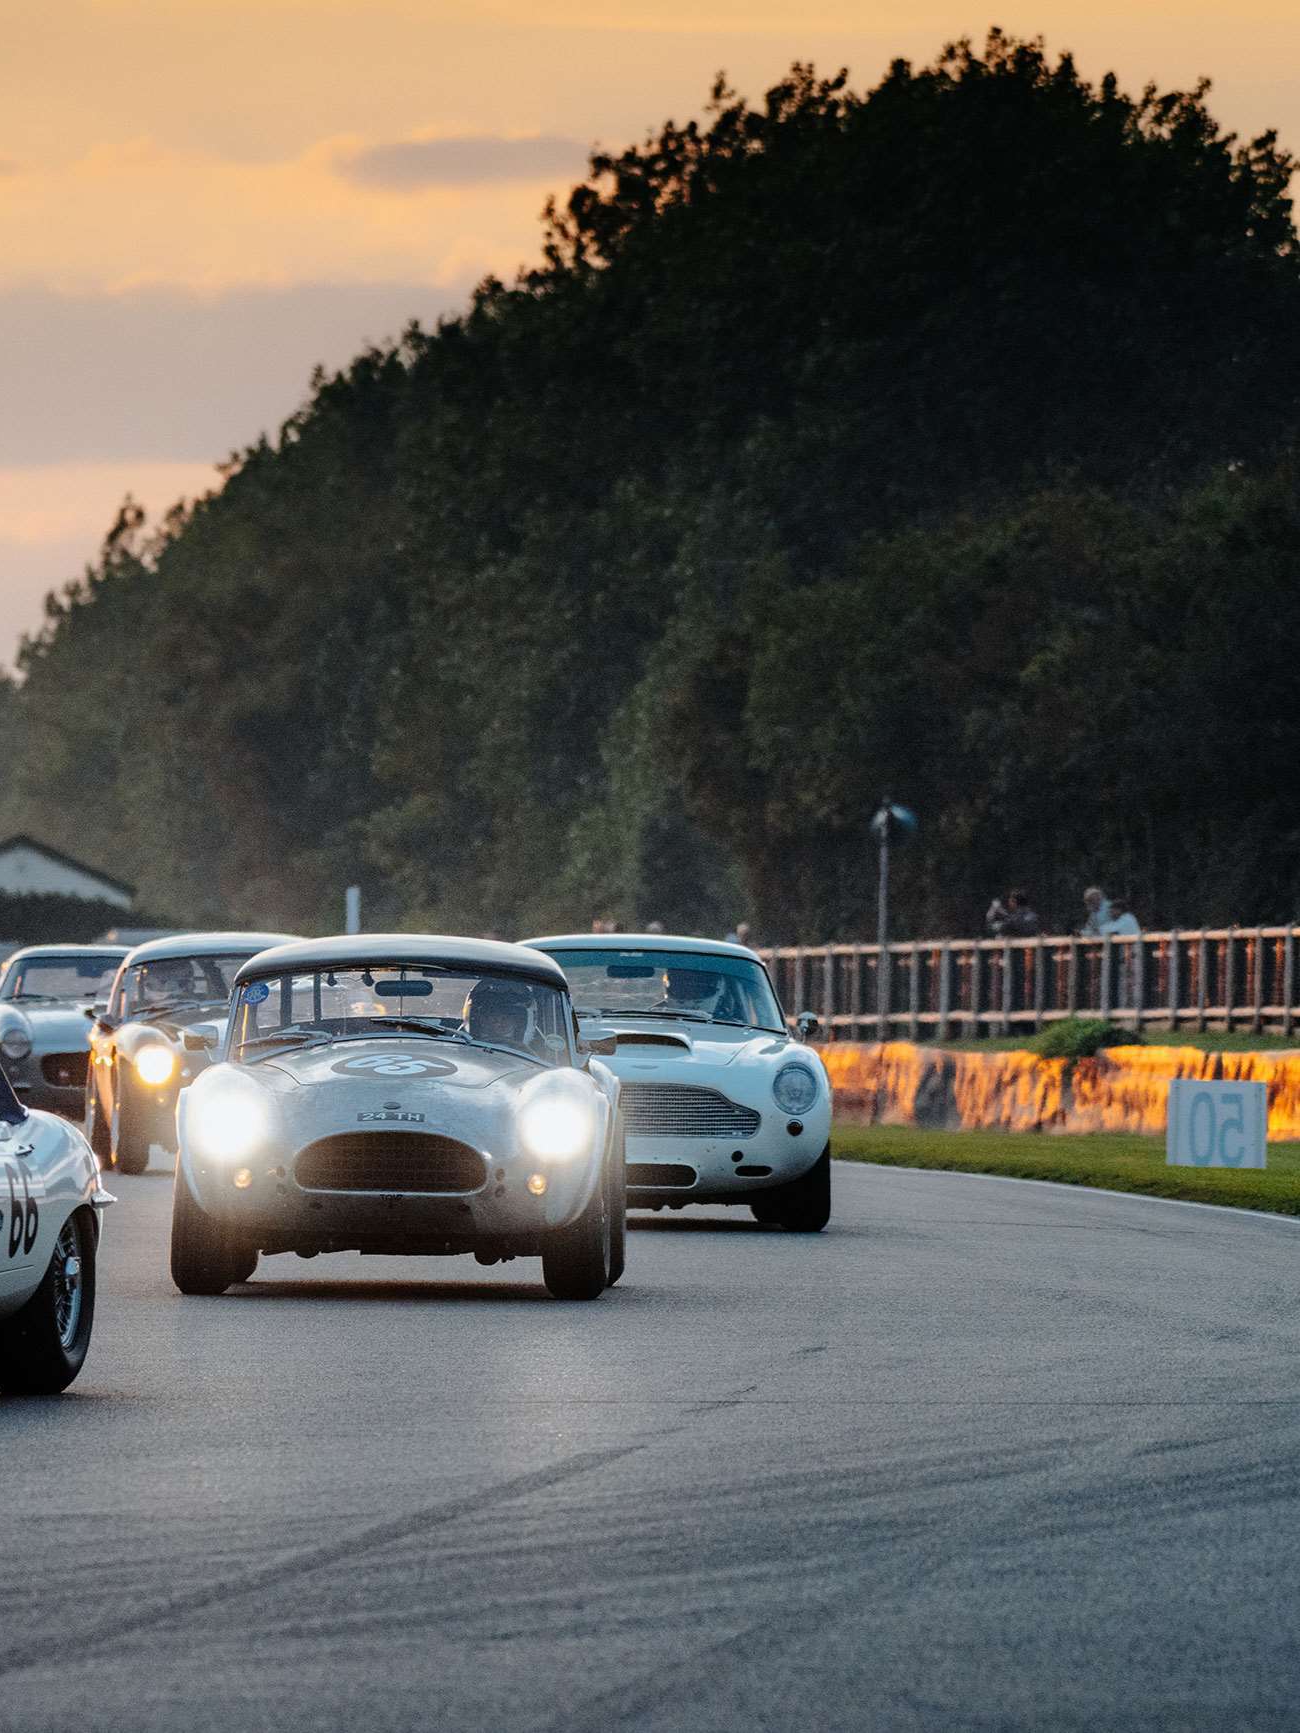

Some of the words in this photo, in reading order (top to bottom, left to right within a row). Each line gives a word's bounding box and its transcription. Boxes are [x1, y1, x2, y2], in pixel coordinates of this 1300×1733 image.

[344, 1054, 451, 1075] 65
[362, 1112, 387, 1121] 24
[396, 1112, 421, 1121] TH
[4, 1160, 39, 1259] 66
